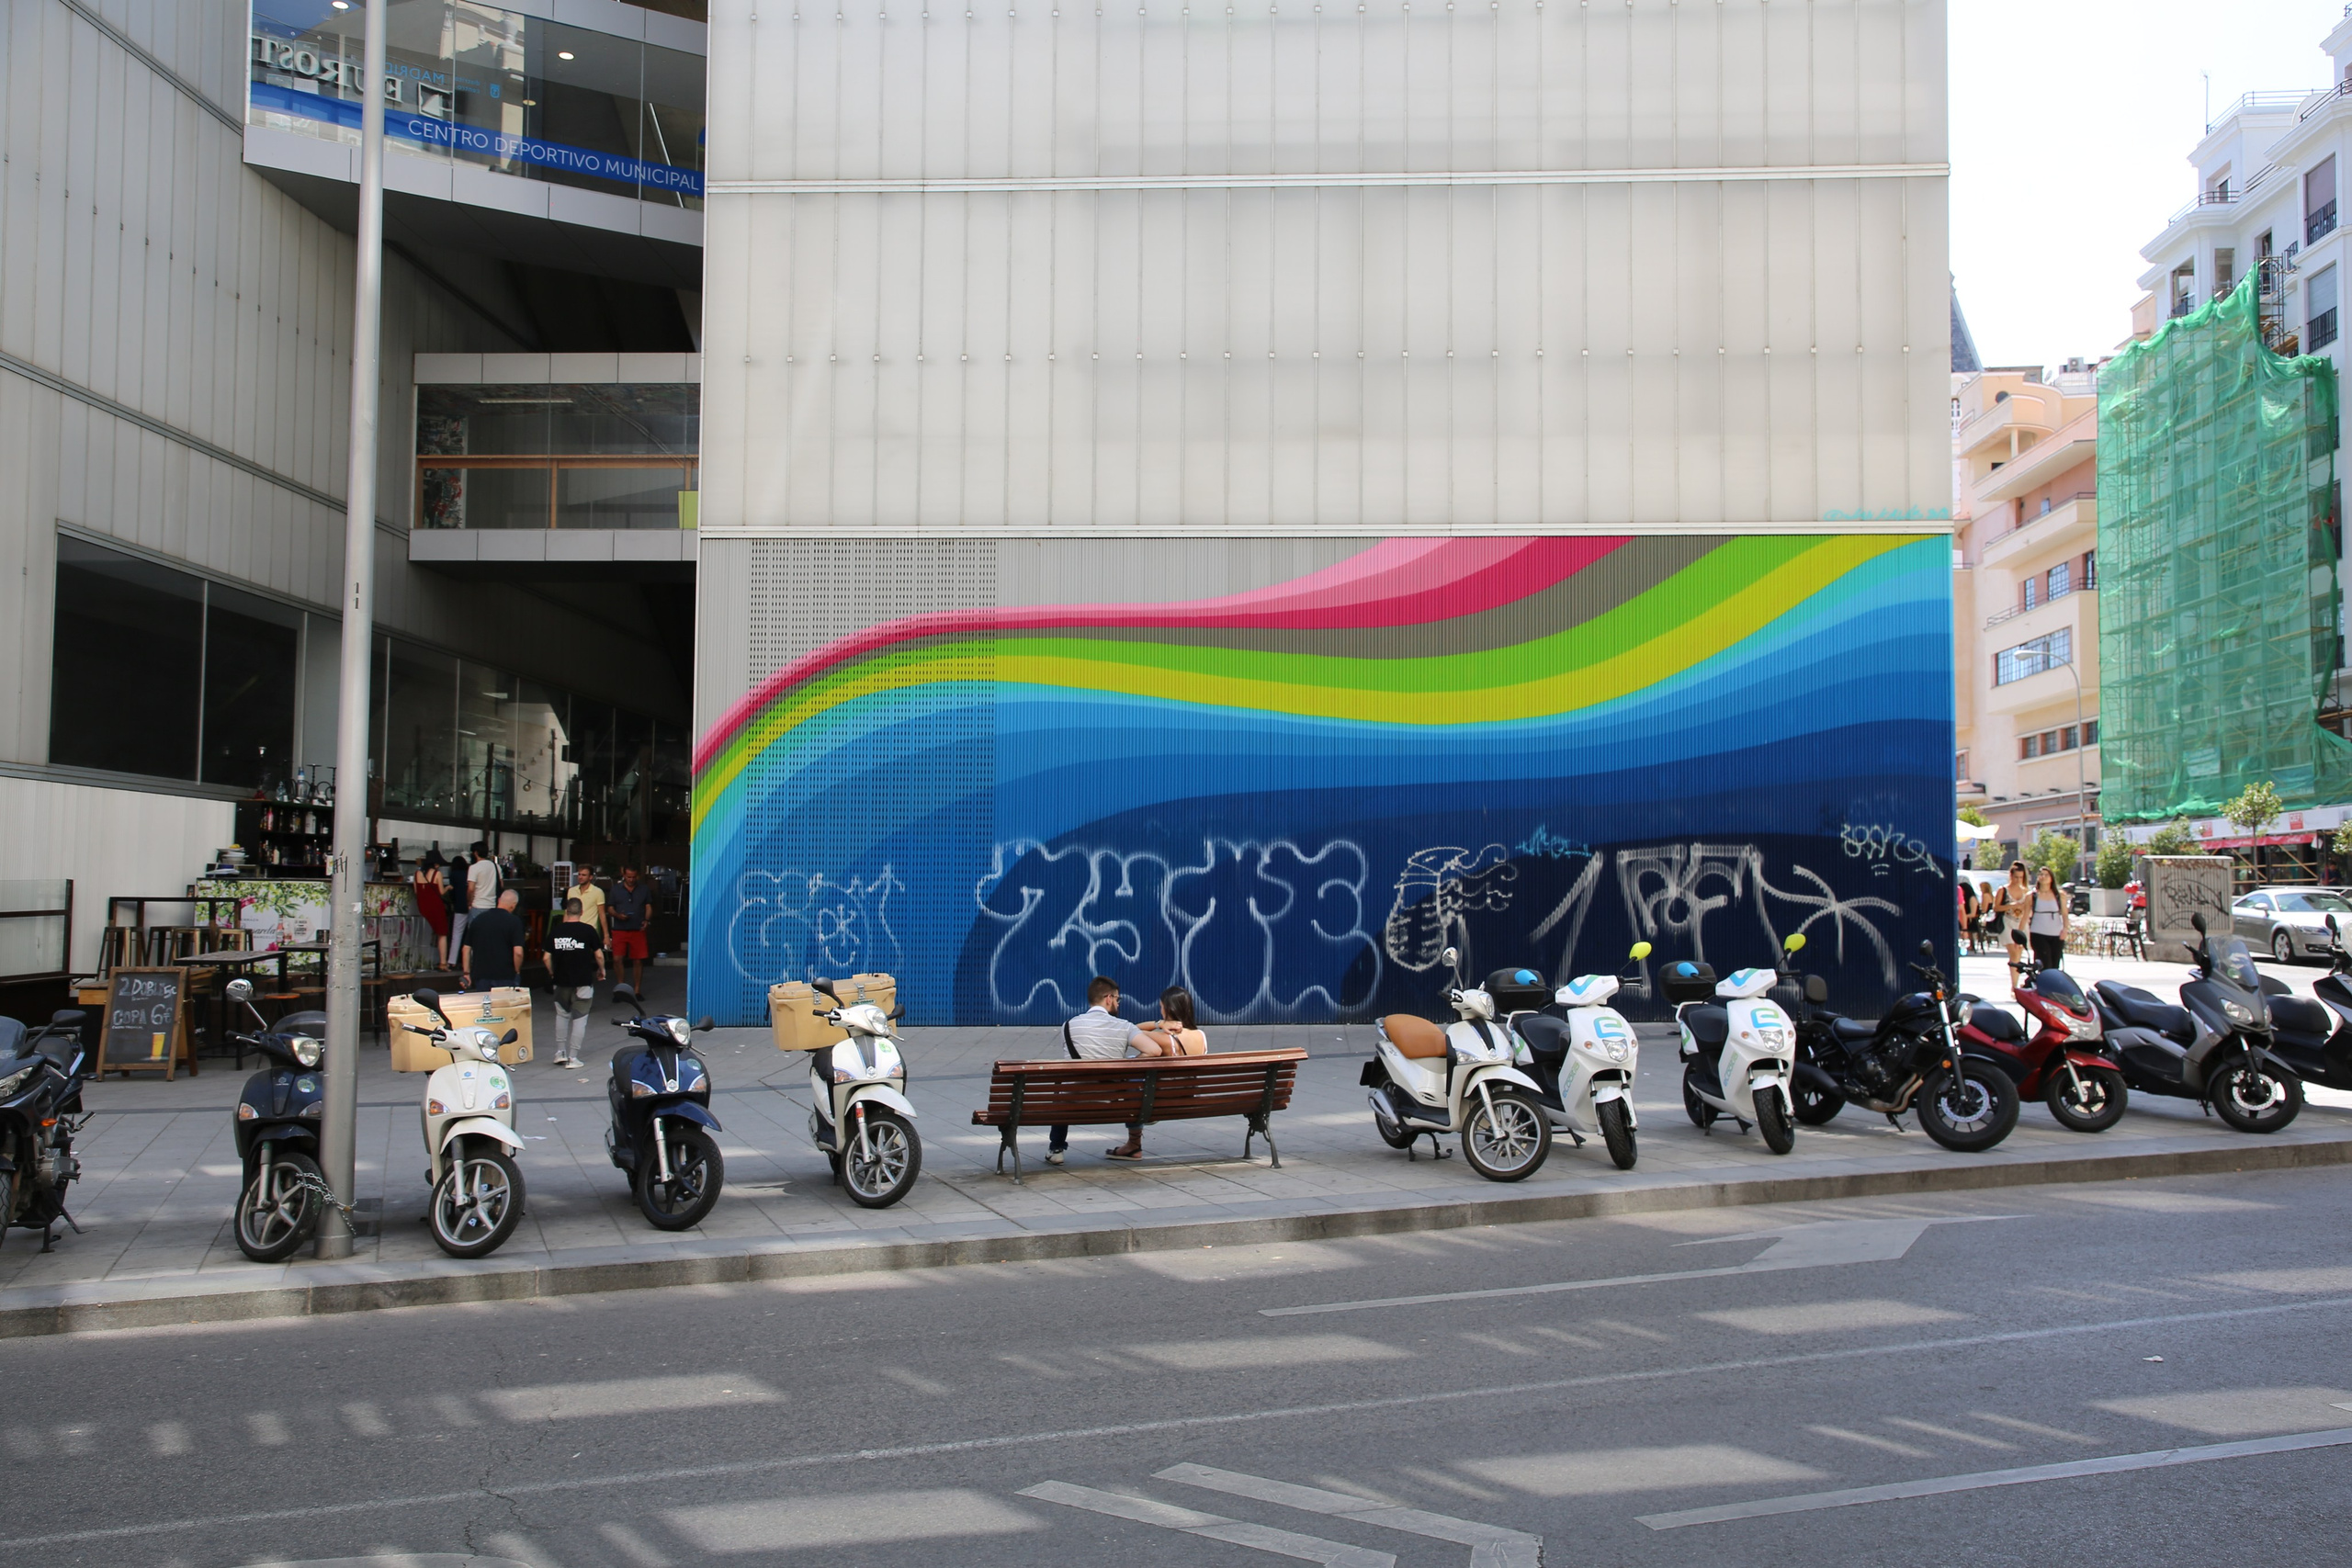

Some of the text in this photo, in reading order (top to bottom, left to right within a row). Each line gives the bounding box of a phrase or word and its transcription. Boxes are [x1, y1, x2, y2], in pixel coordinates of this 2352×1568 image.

[408, 119, 700, 191] CENTRO DEPORTIVO MUNICIPAL
[119, 977, 130, 996] 2
[113, 1003, 173, 1025] COPA 6€
